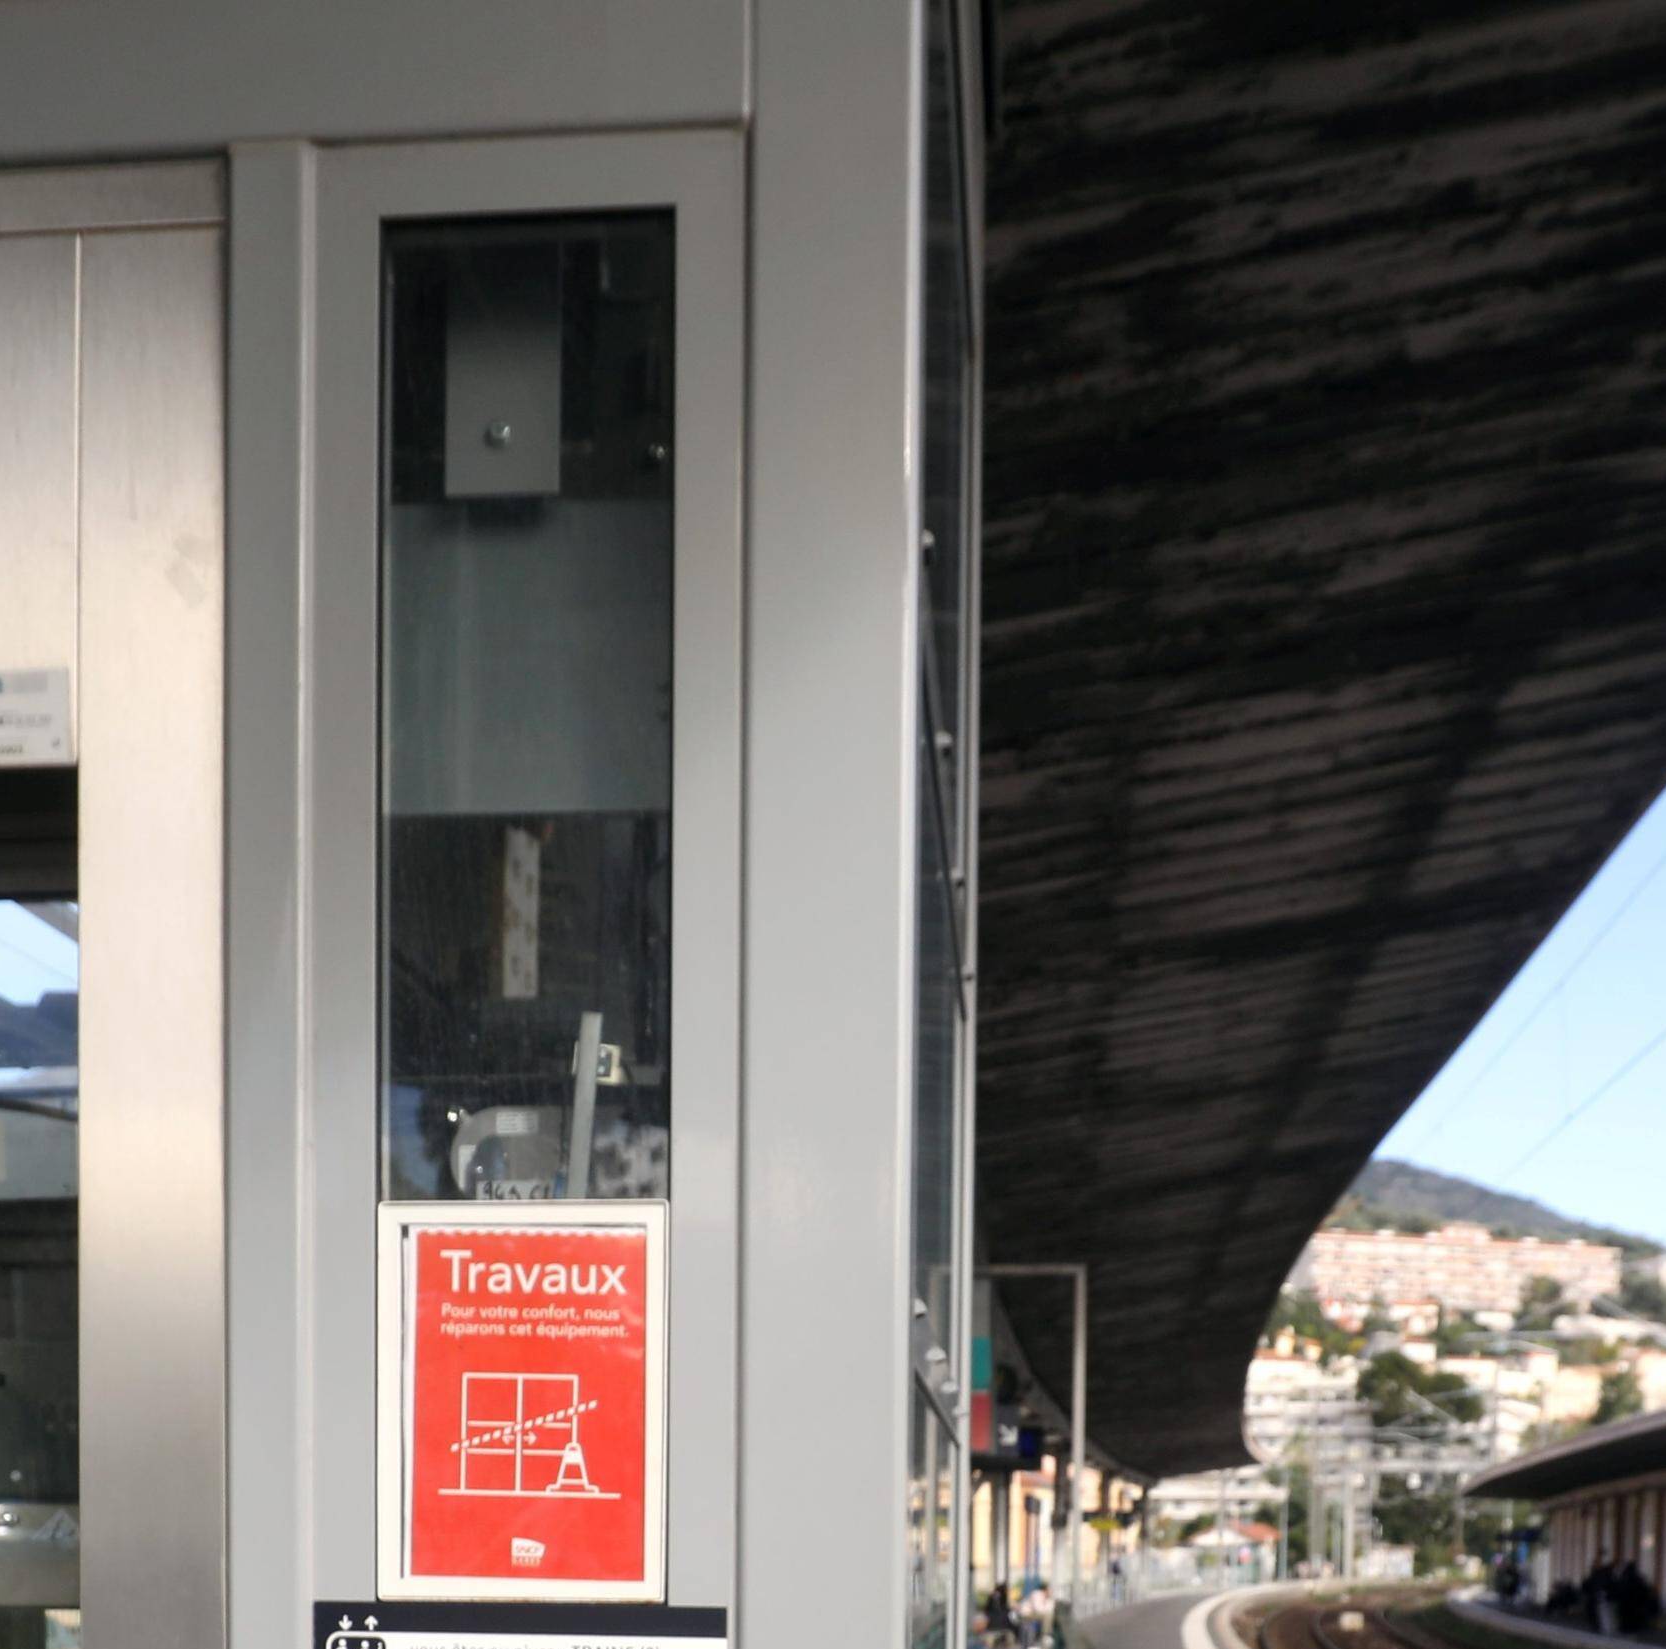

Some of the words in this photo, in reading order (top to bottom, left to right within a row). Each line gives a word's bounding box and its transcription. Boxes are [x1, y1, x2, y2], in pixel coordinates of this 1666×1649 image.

[440, 1249, 627, 1296] Travaux
[441, 1303, 475, 1318] Pour
[480, 1304, 519, 1319] votre
[521, 1303, 579, 1321] confort,
[584, 1307, 620, 1320] nous
[440, 1320, 506, 1339] réparons
[509, 1322, 533, 1336] cet
[536, 1322, 629, 1340] équipement.
